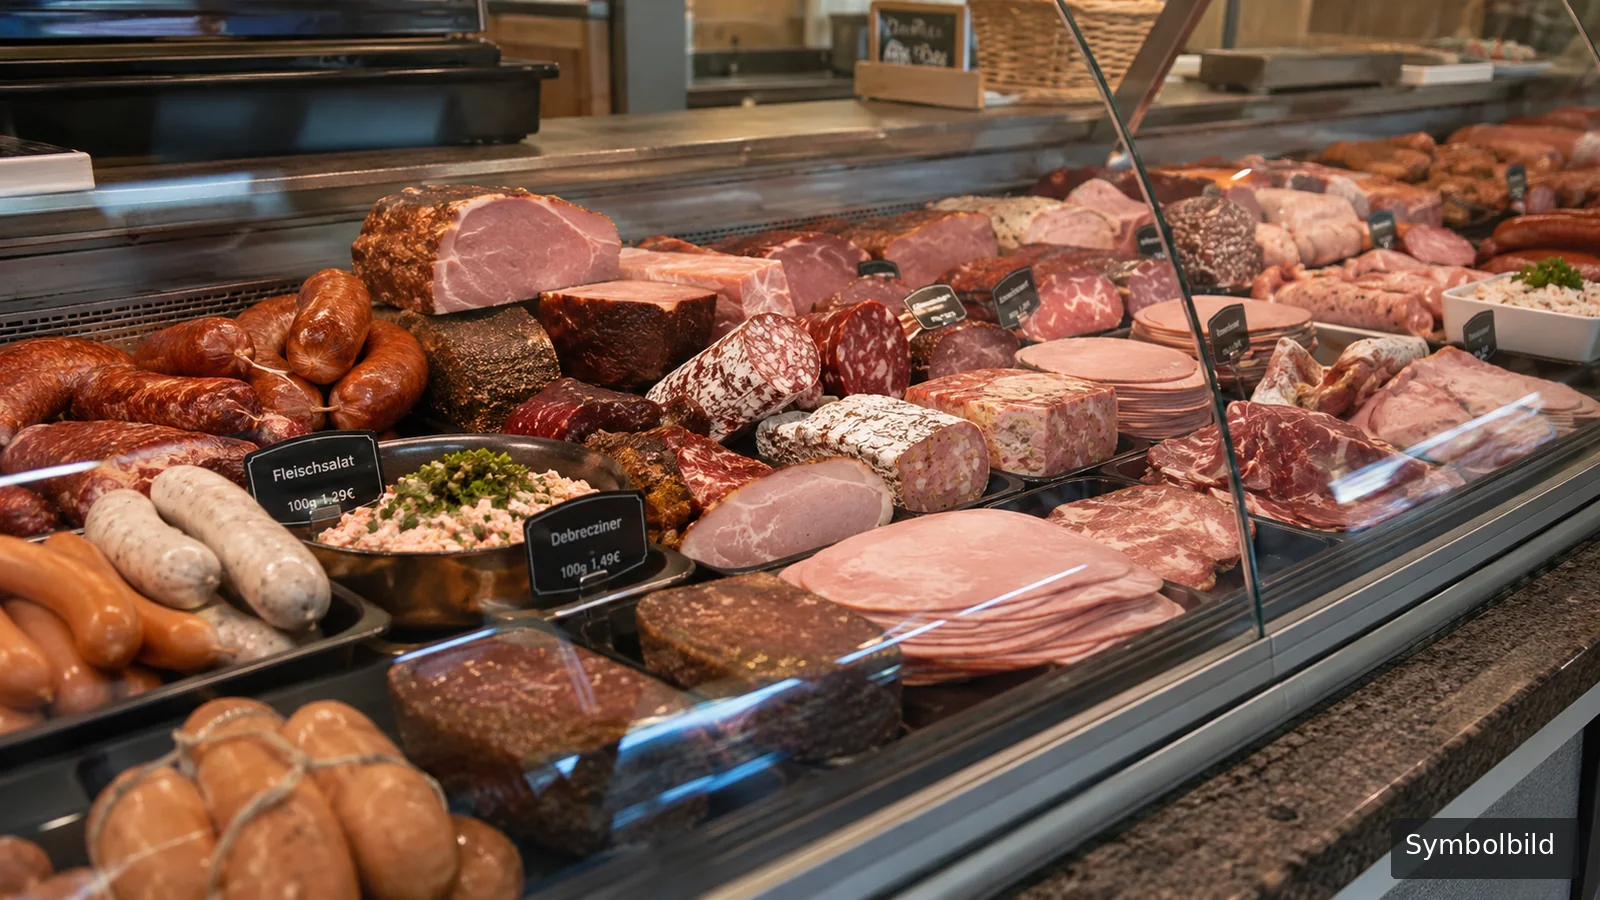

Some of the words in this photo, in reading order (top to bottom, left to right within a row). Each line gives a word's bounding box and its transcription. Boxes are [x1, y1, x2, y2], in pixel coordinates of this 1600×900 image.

[272, 455, 355, 482] Fleischsalat
[288, 498, 317, 512] 100g
[550, 518, 622, 547] Debrecziner
[560, 563, 587, 579] 100g
[590, 550, 621, 570] 1,49€
